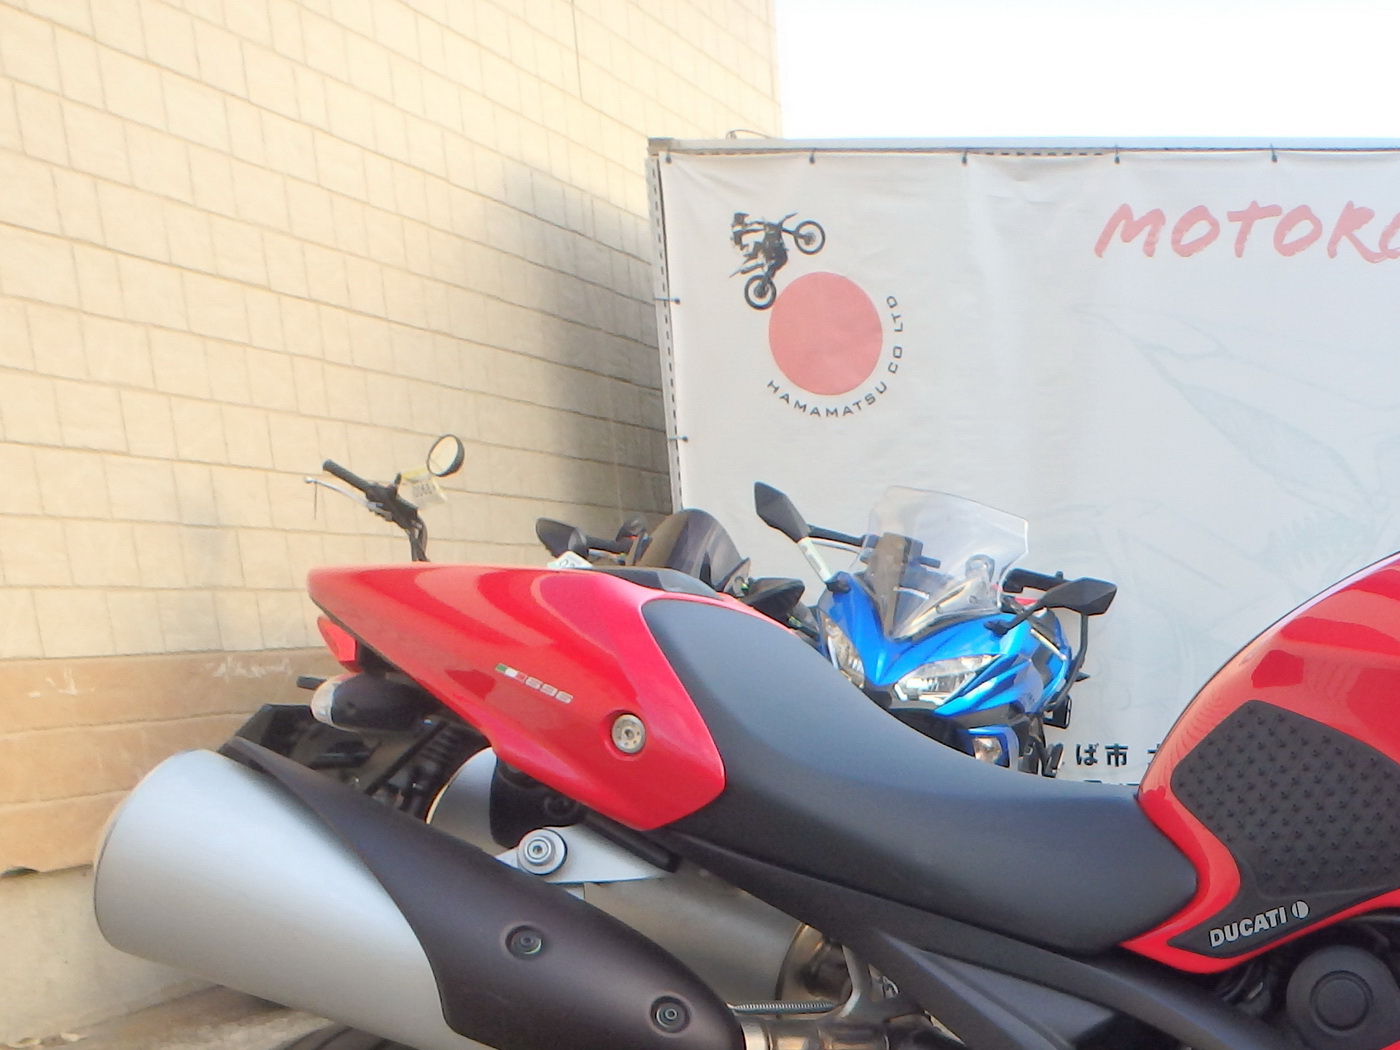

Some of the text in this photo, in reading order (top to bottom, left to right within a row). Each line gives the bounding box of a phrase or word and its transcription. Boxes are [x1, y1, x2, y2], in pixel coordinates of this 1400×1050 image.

[766, 295, 904, 418] HAMAMATSU CO LTD
[1209, 906, 1287, 948] DUCATI
